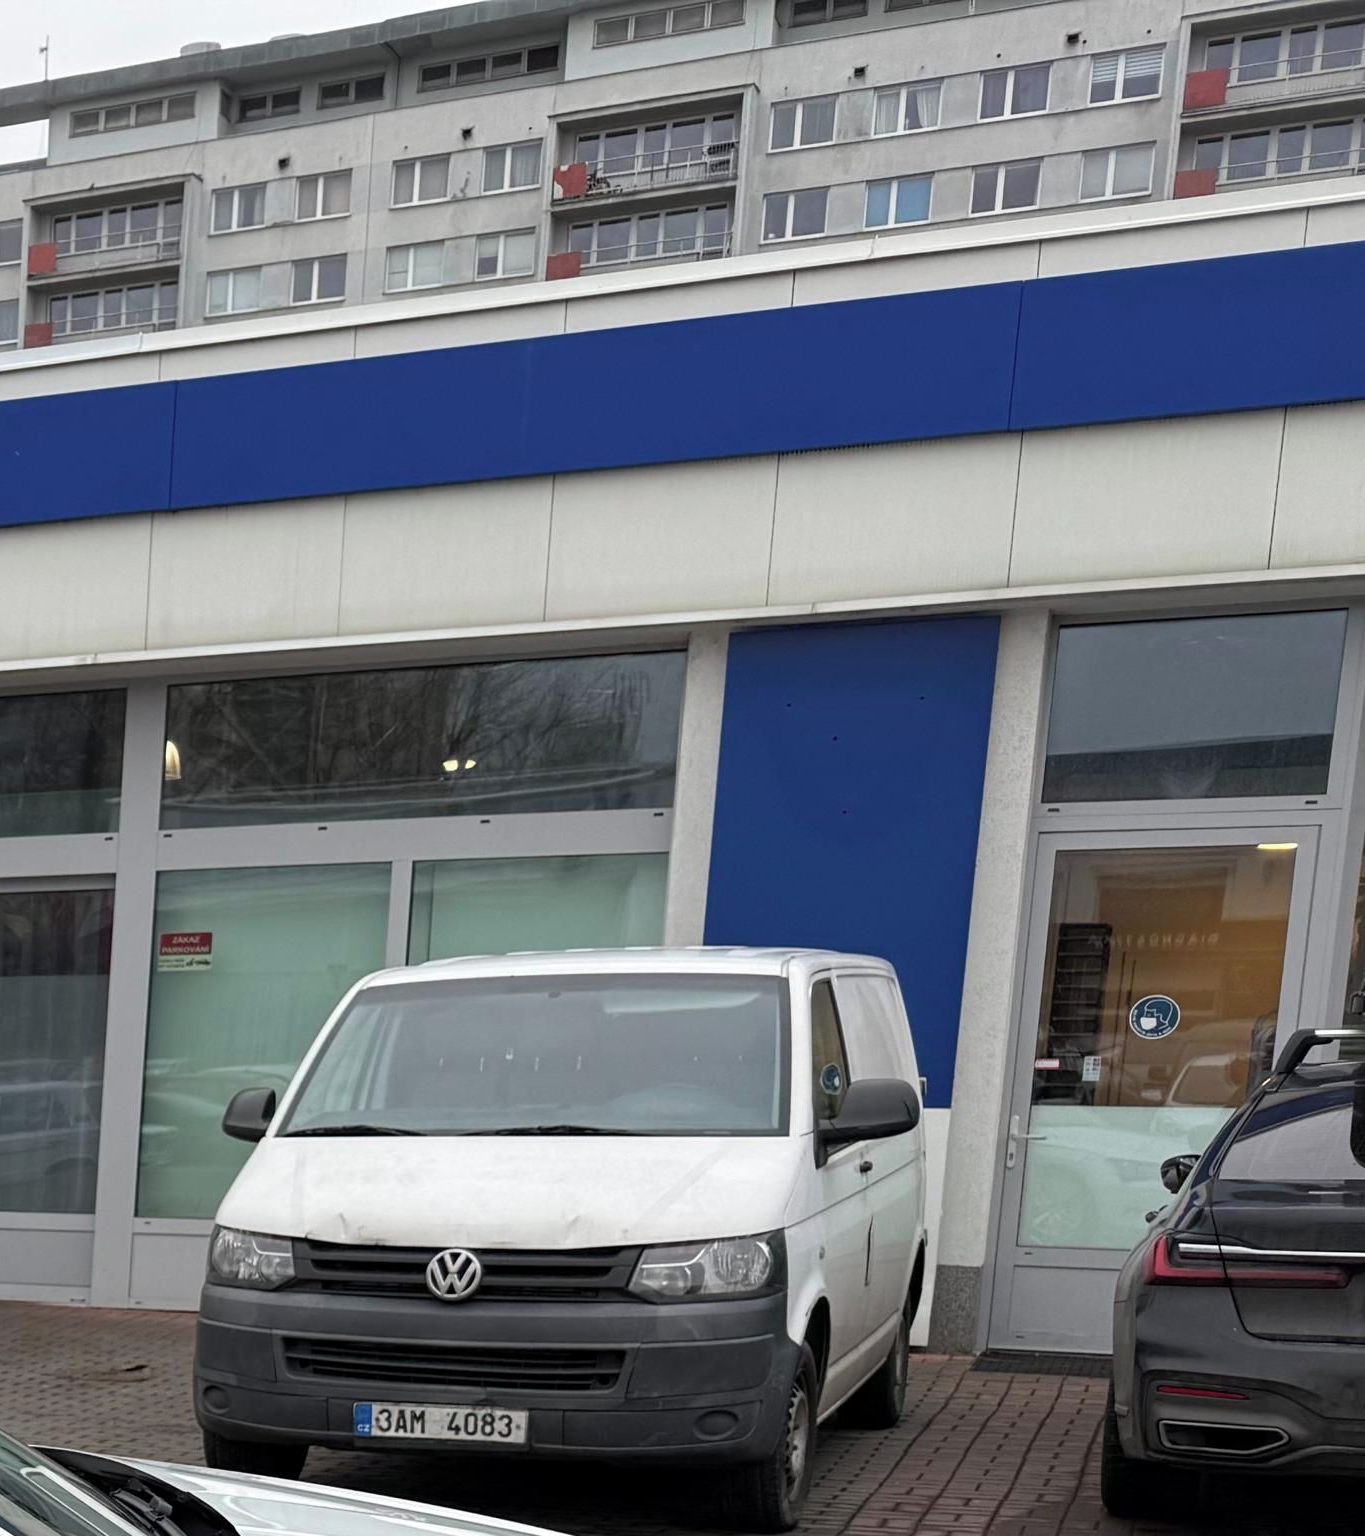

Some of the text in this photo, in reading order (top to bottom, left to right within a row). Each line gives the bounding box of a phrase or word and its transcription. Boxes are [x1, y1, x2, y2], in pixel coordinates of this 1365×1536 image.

[357, 1408, 513, 1438] CZ 3AM 4083
